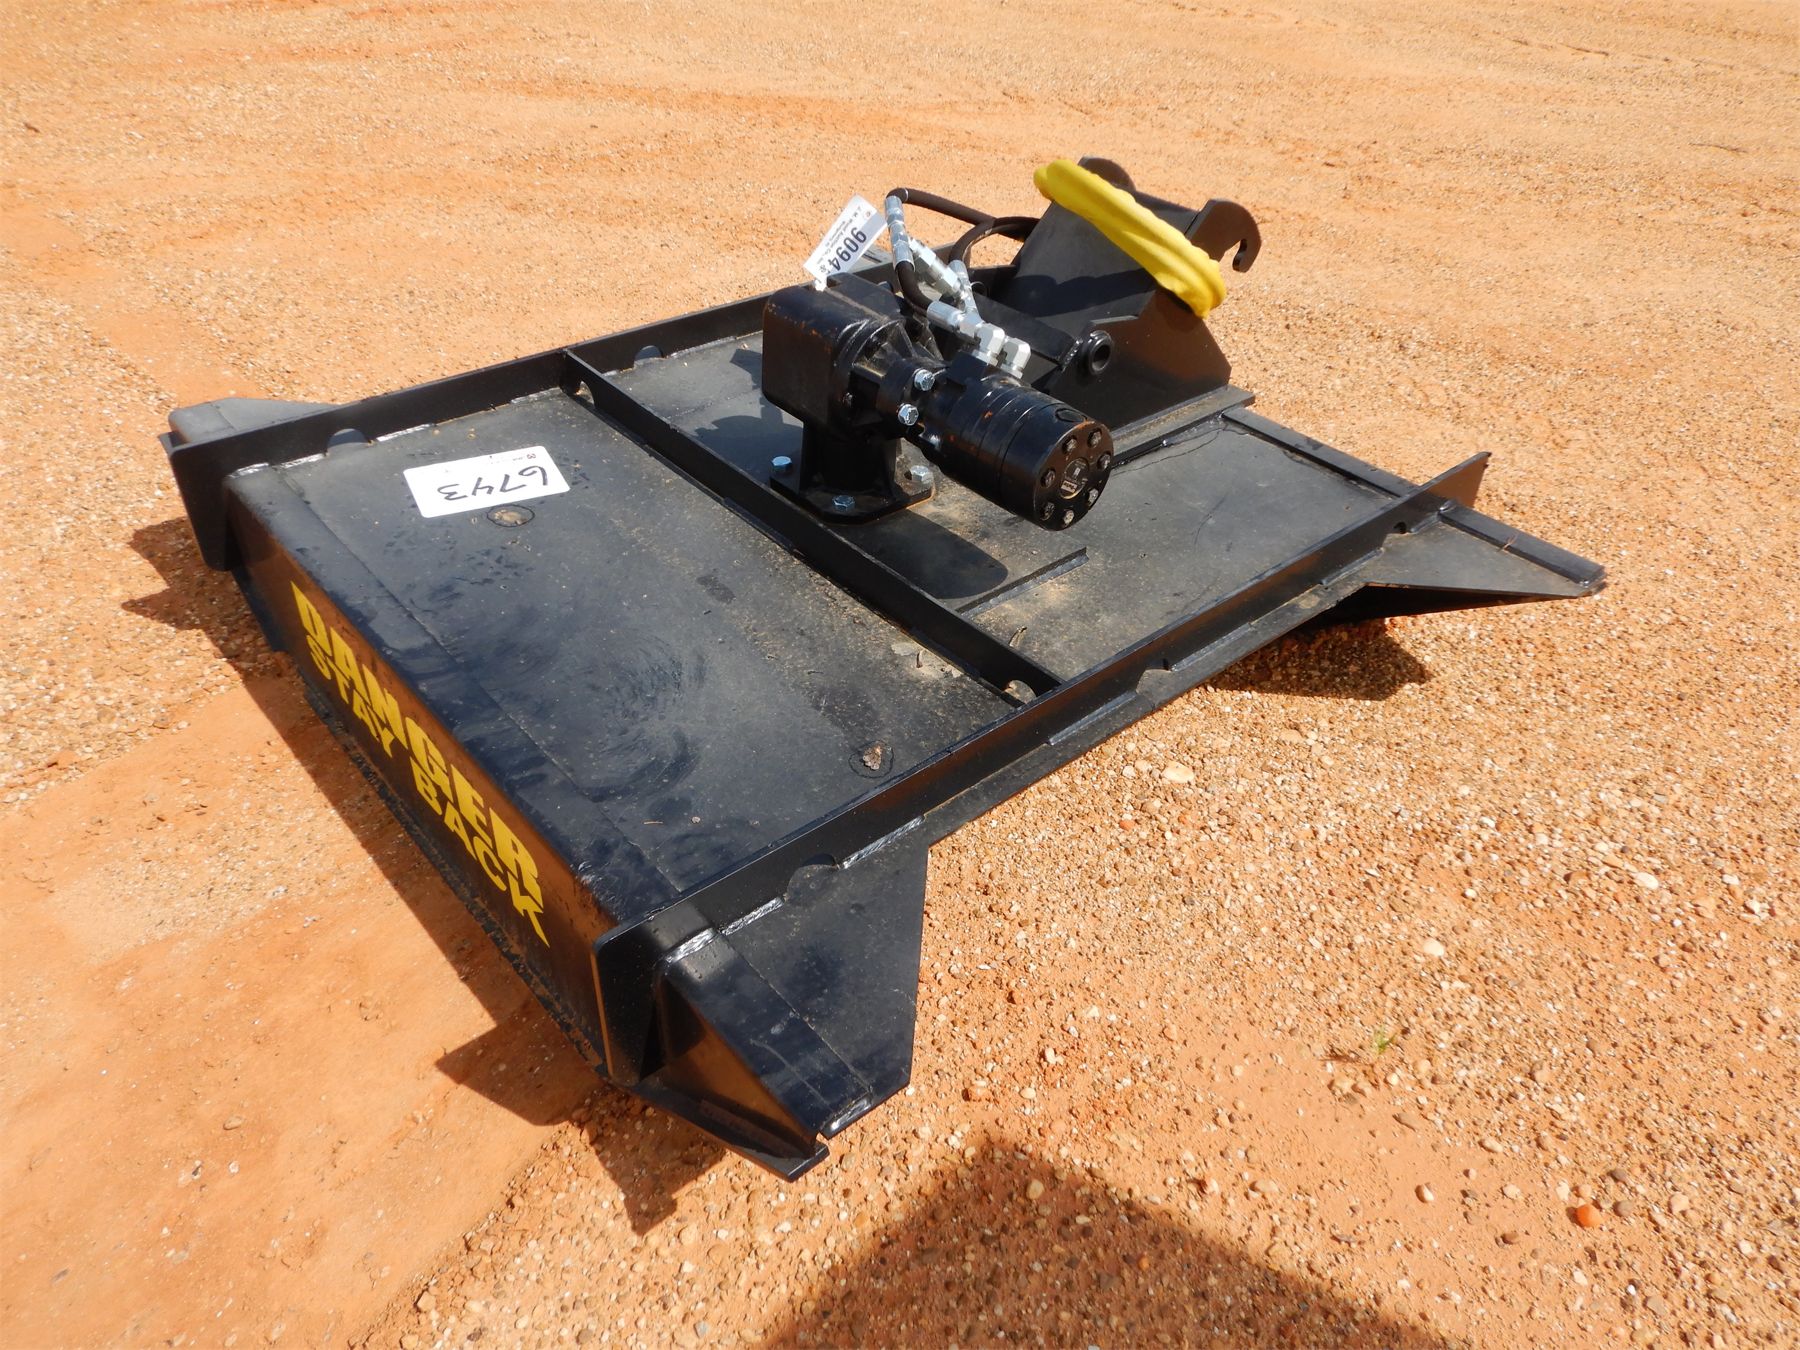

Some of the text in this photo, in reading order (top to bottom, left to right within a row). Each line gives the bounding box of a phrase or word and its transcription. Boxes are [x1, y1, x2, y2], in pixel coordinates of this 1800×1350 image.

[828, 227, 867, 271] 9094
[437, 465, 548, 501] 6743
[290, 580, 544, 913] DANGER
[306, 634, 550, 948] STAY BACK
